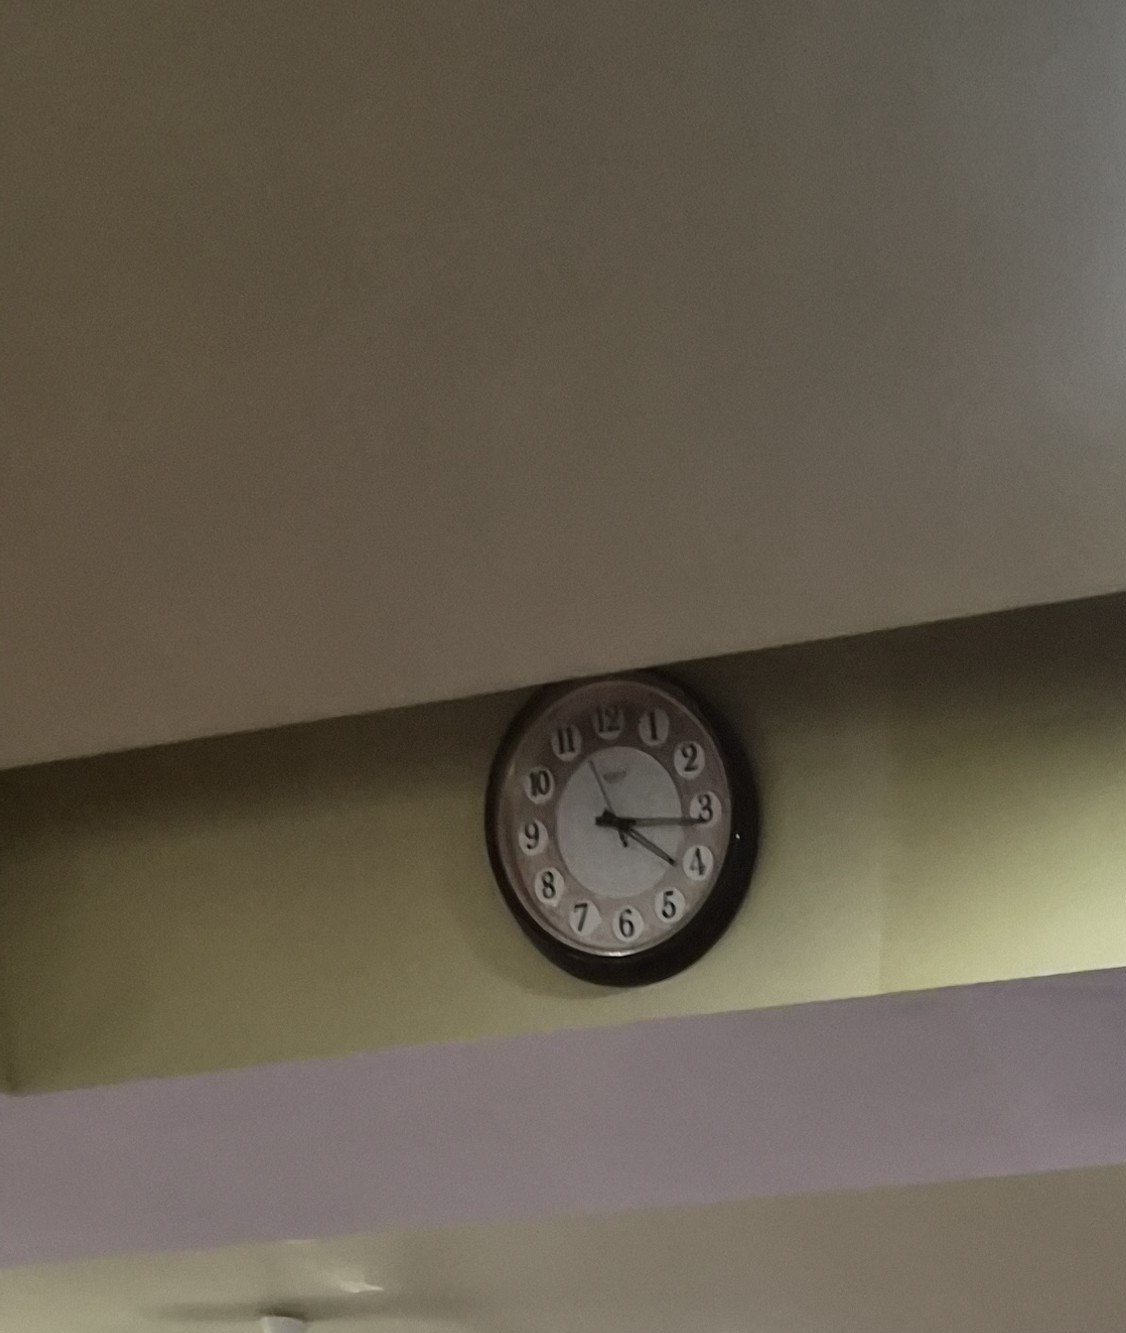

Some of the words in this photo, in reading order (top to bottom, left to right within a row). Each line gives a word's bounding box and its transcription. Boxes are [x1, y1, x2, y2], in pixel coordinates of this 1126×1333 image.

[598, 705, 621, 733] 12
[556, 726, 574, 755] 11
[681, 742, 698, 773] 2
[528, 770, 550, 797] 10
[698, 793, 714, 824] 3
[525, 822, 540, 851] 9
[689, 847, 706, 877] 4
[540, 870, 556, 900] 8
[573, 902, 588, 933] 7
[660, 890, 677, 921] 5
[618, 908, 634, 938] 6
